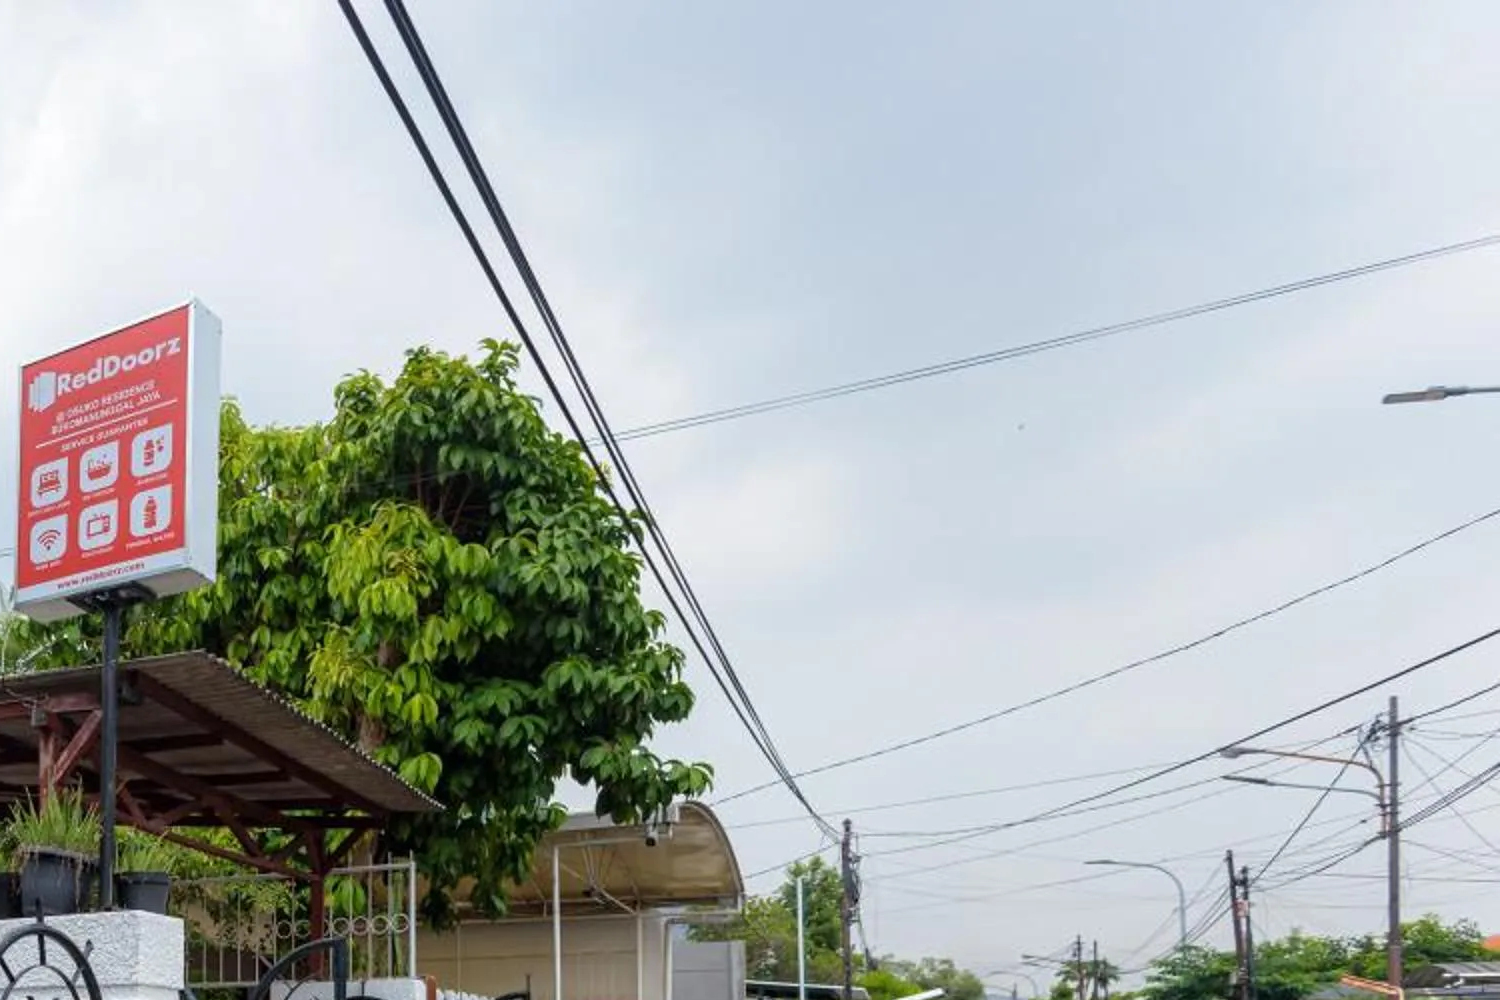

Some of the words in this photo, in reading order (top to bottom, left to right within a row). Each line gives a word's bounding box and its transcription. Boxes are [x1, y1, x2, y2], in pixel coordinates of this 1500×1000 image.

[57, 337, 181, 396] RedDoorz
[101, 379, 156, 404] RESIDENCE
[61, 434, 94, 452] SERVICE
